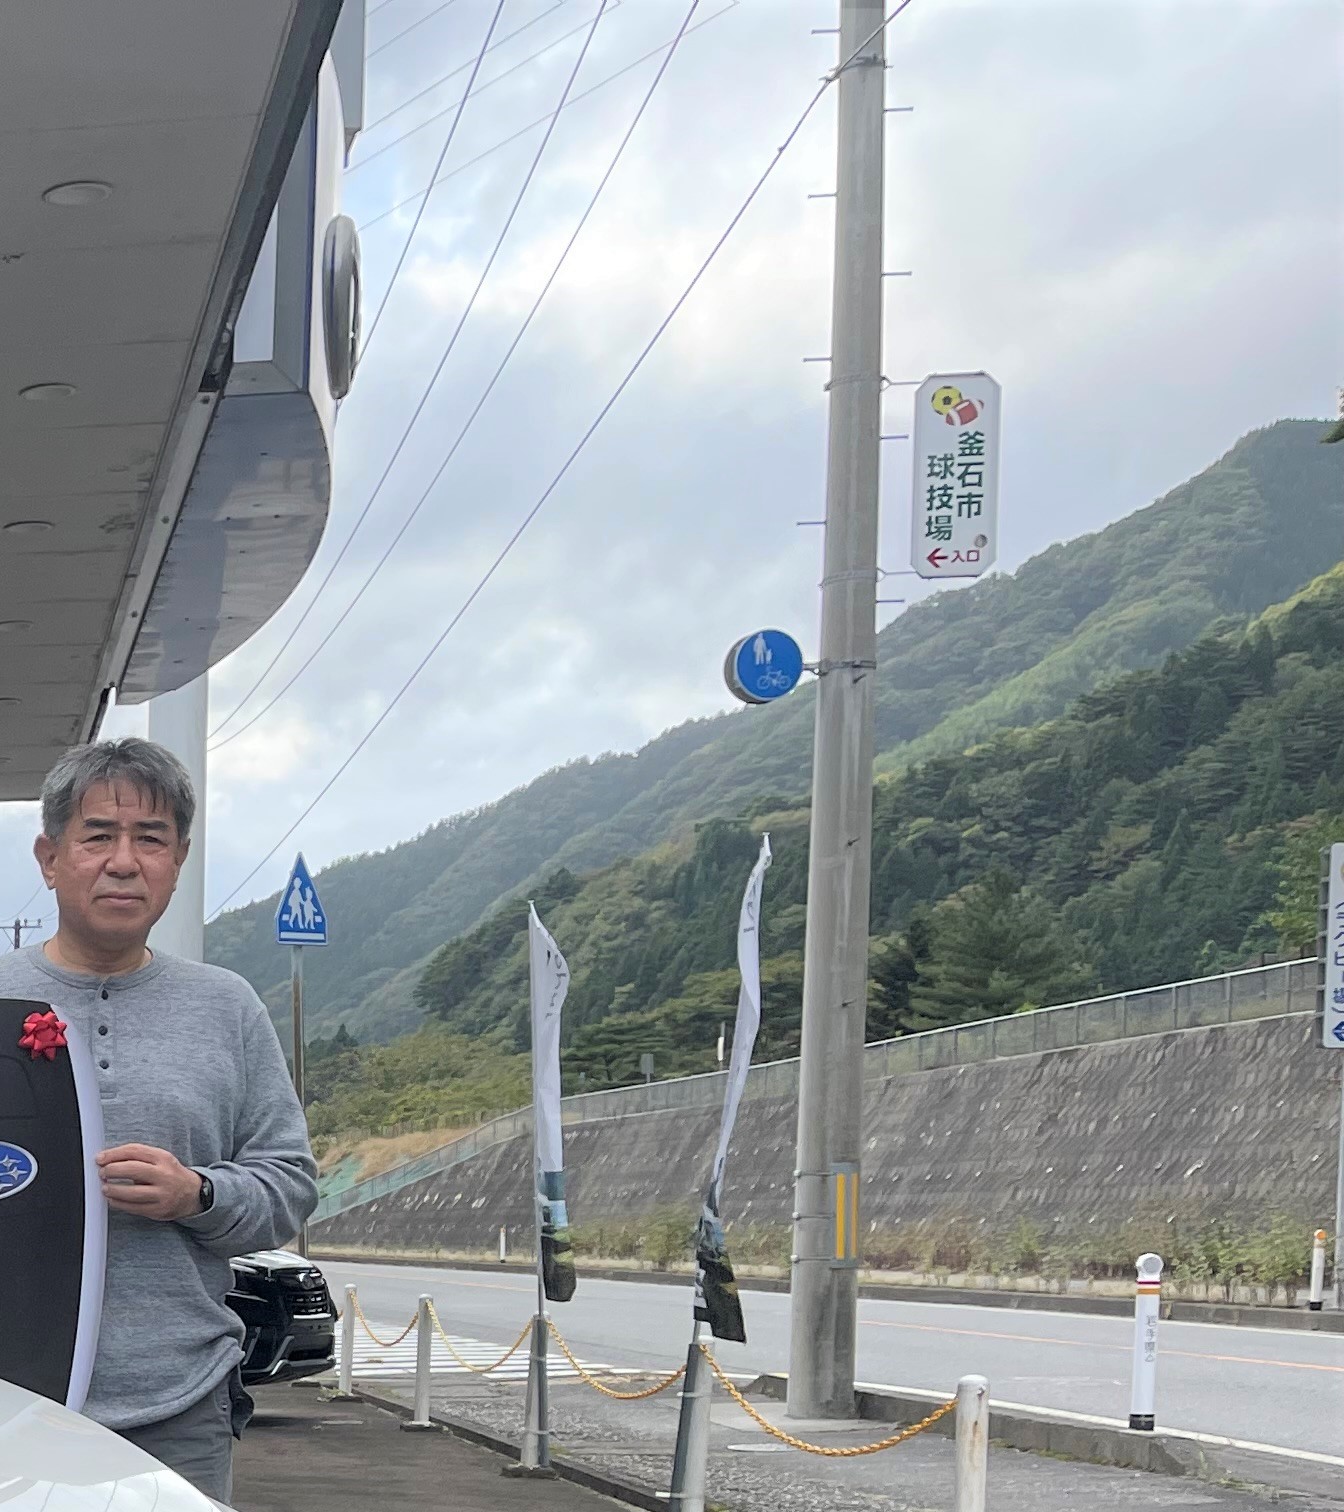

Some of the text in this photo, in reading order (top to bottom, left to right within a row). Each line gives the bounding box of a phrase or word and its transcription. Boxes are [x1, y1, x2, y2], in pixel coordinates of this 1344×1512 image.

[925, 453, 955, 542] 球技場
[956, 430, 986, 519] 釜石市
[950, 549, 980, 564] 入口
